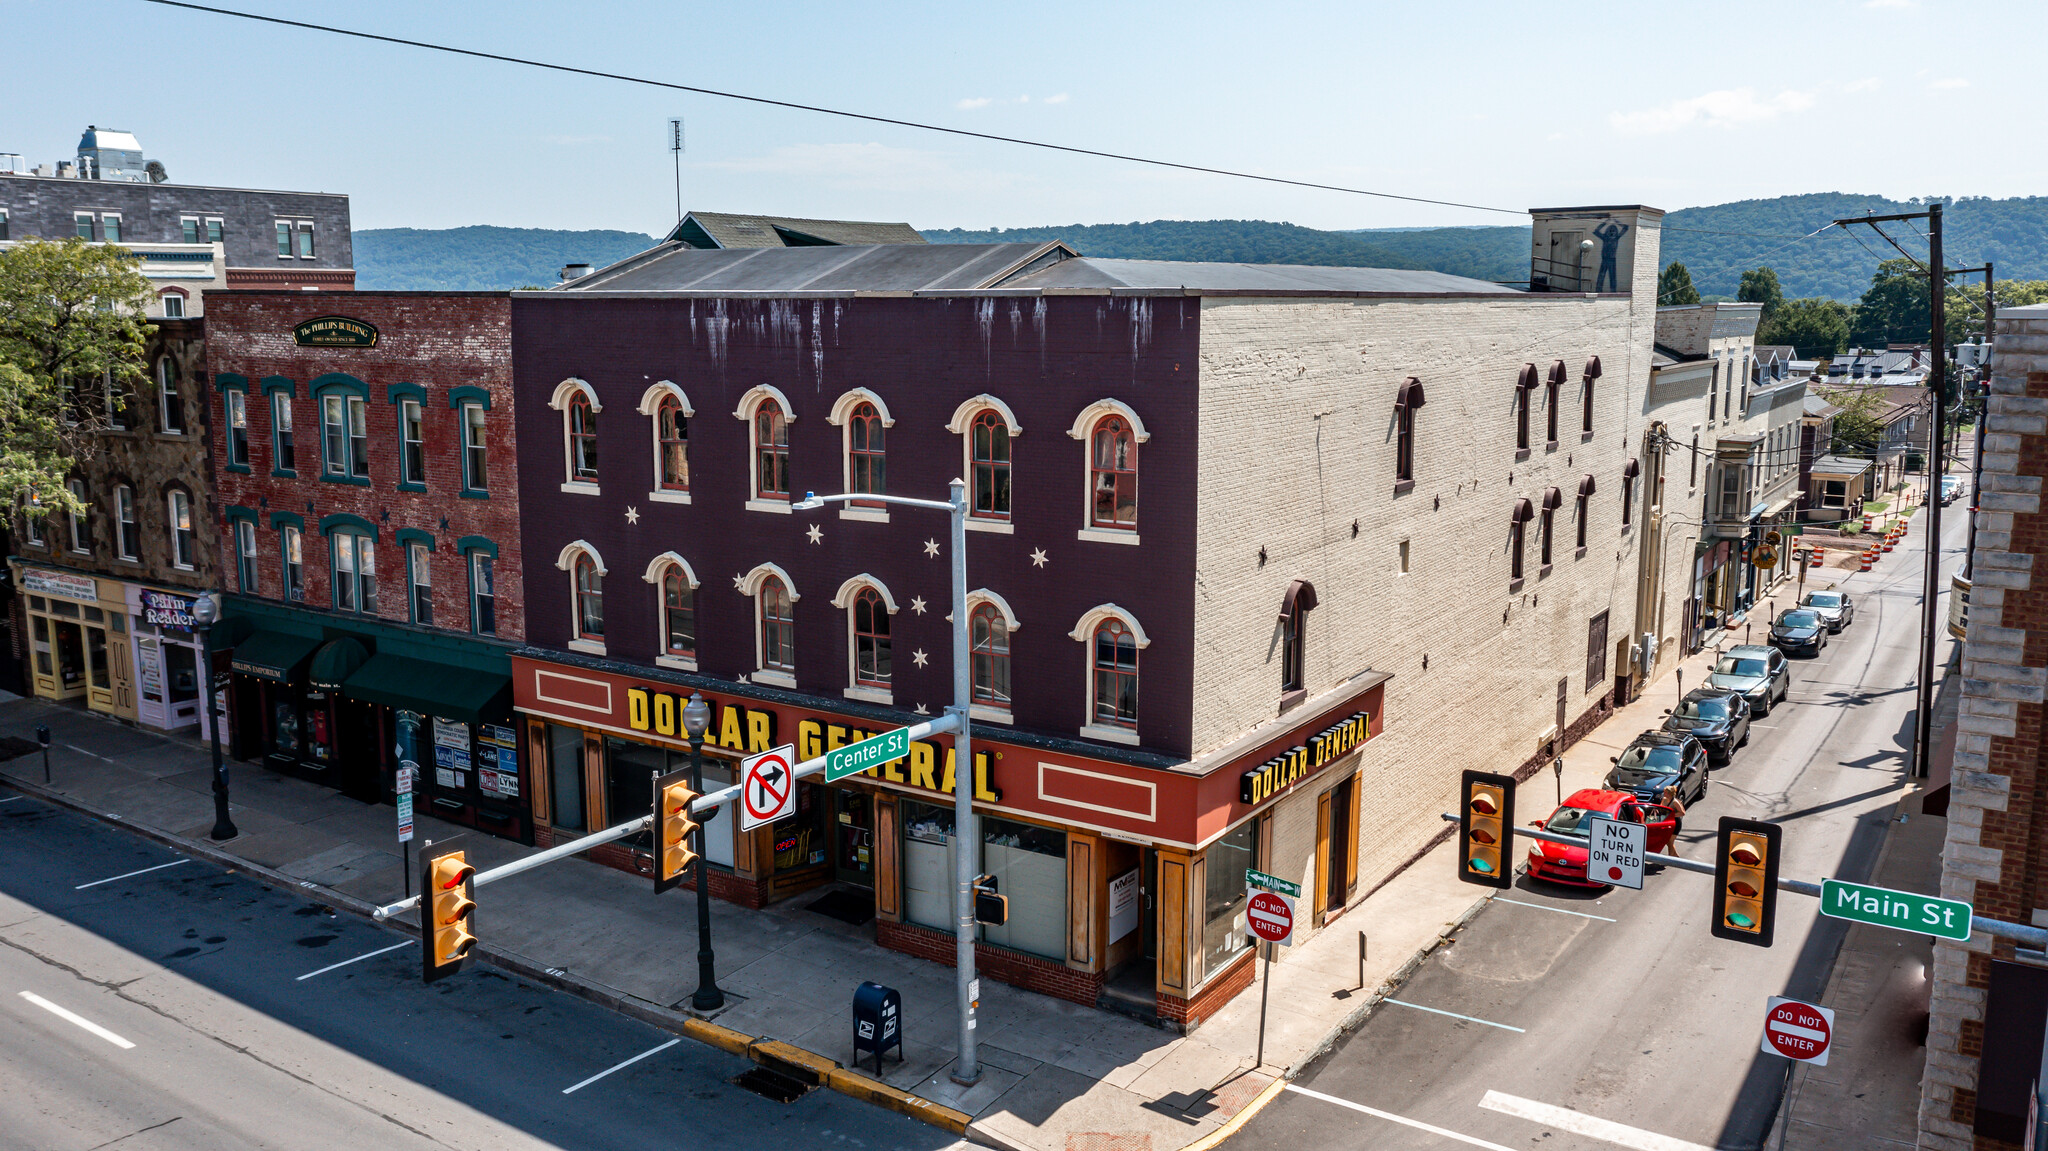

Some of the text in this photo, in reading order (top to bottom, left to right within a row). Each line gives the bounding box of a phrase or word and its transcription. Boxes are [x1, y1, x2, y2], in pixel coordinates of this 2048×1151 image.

[300, 321, 368, 337] The PHILLIPS BUILDING
[58, 575, 91, 587] RESTAURANT
[150, 594, 187, 612] Palm
[145, 608, 195, 626] Reader
[252, 665, 281, 679] EMPORIUM
[435, 723, 454, 731] COLUMBIA
[435, 729, 457, 738] DEMOCRATIC
[833, 734, 903, 771] Center St
[1252, 713, 1371, 805] DOLLAR GENERAL
[1606, 824, 1630, 839] NO
[776, 838, 797, 851] OPEN
[1601, 838, 1633, 853] TURN
[1593, 850, 1639, 867] ON RED
[1246, 869, 1301, 896] E MAIN W
[1255, 899, 1286, 915] DO NOT
[1837, 887, 1955, 928] Main St
[1256, 920, 1282, 935] ENTER
[1777, 1010, 1821, 1028] DO NOT
[1777, 1034, 1814, 1052] ENTER
[905, 1097, 932, 1108] 417
